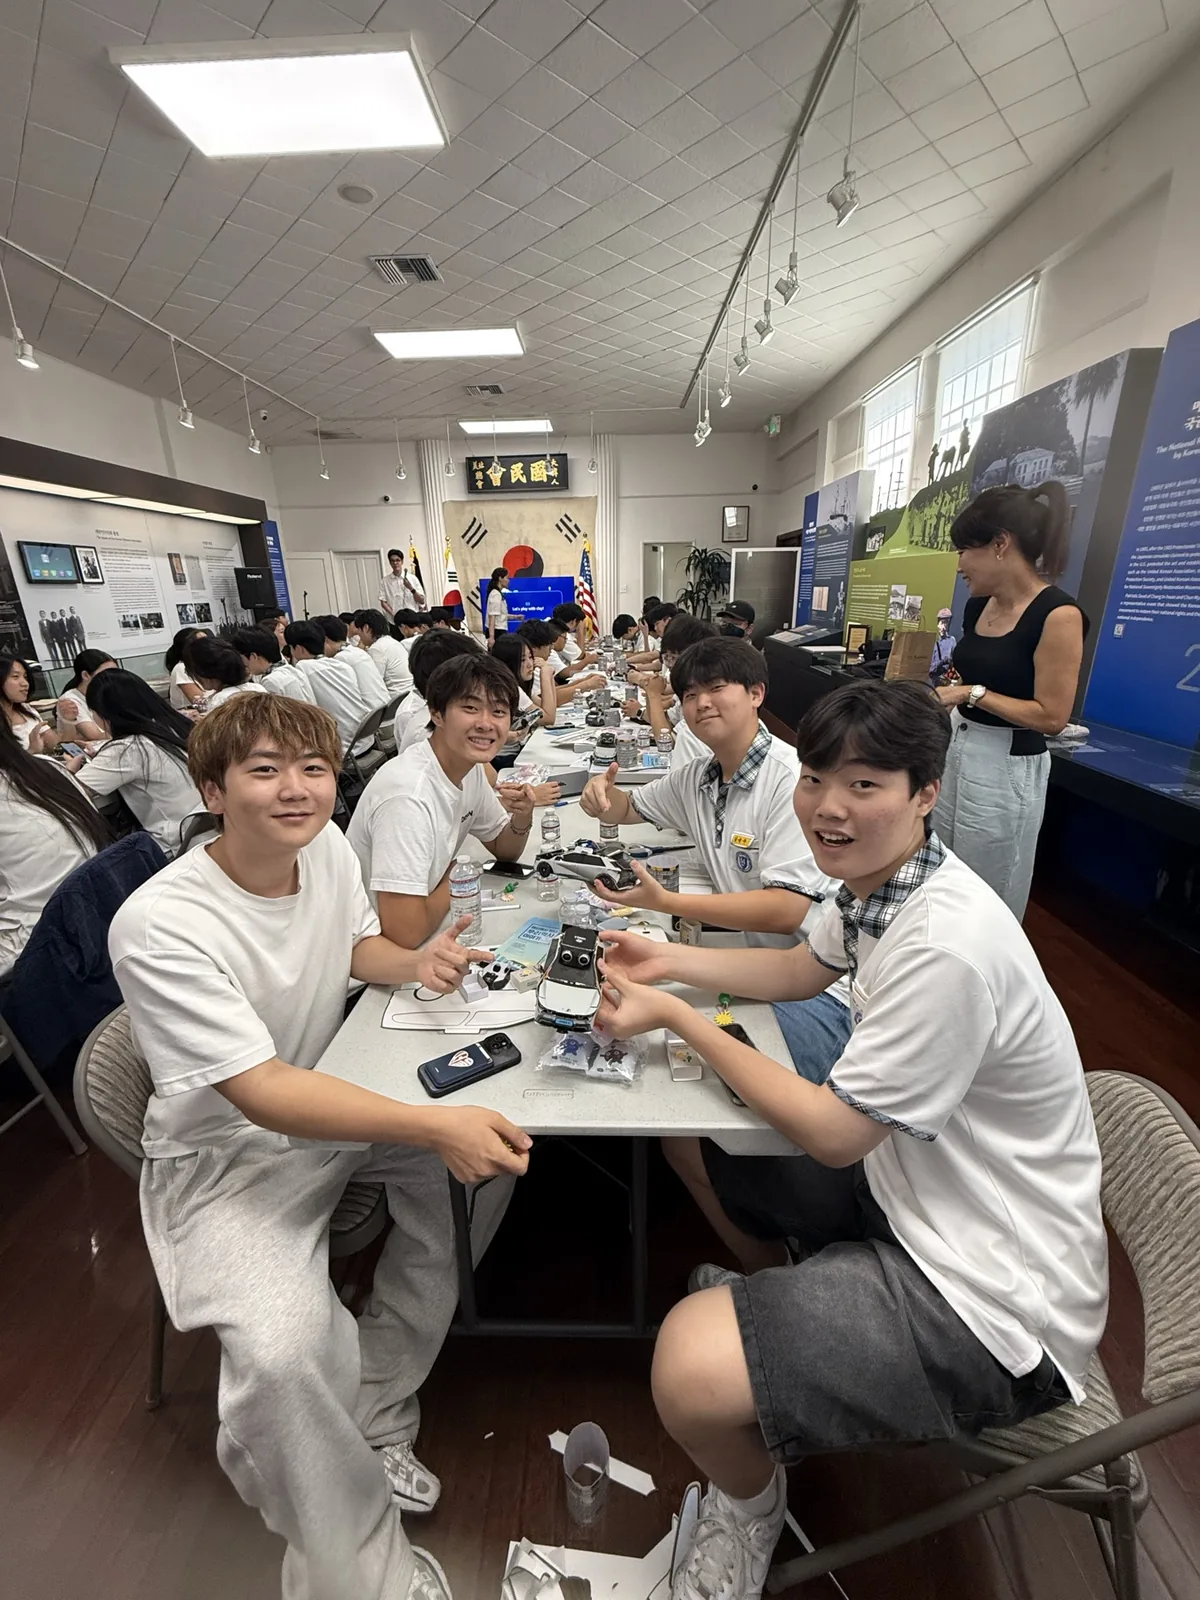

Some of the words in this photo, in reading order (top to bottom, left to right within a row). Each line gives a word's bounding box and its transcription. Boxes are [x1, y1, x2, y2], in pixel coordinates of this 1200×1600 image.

[1156, 446, 1168, 454] The
[1168, 438, 1196, 450] National
[1172, 452, 1182, 460] by
